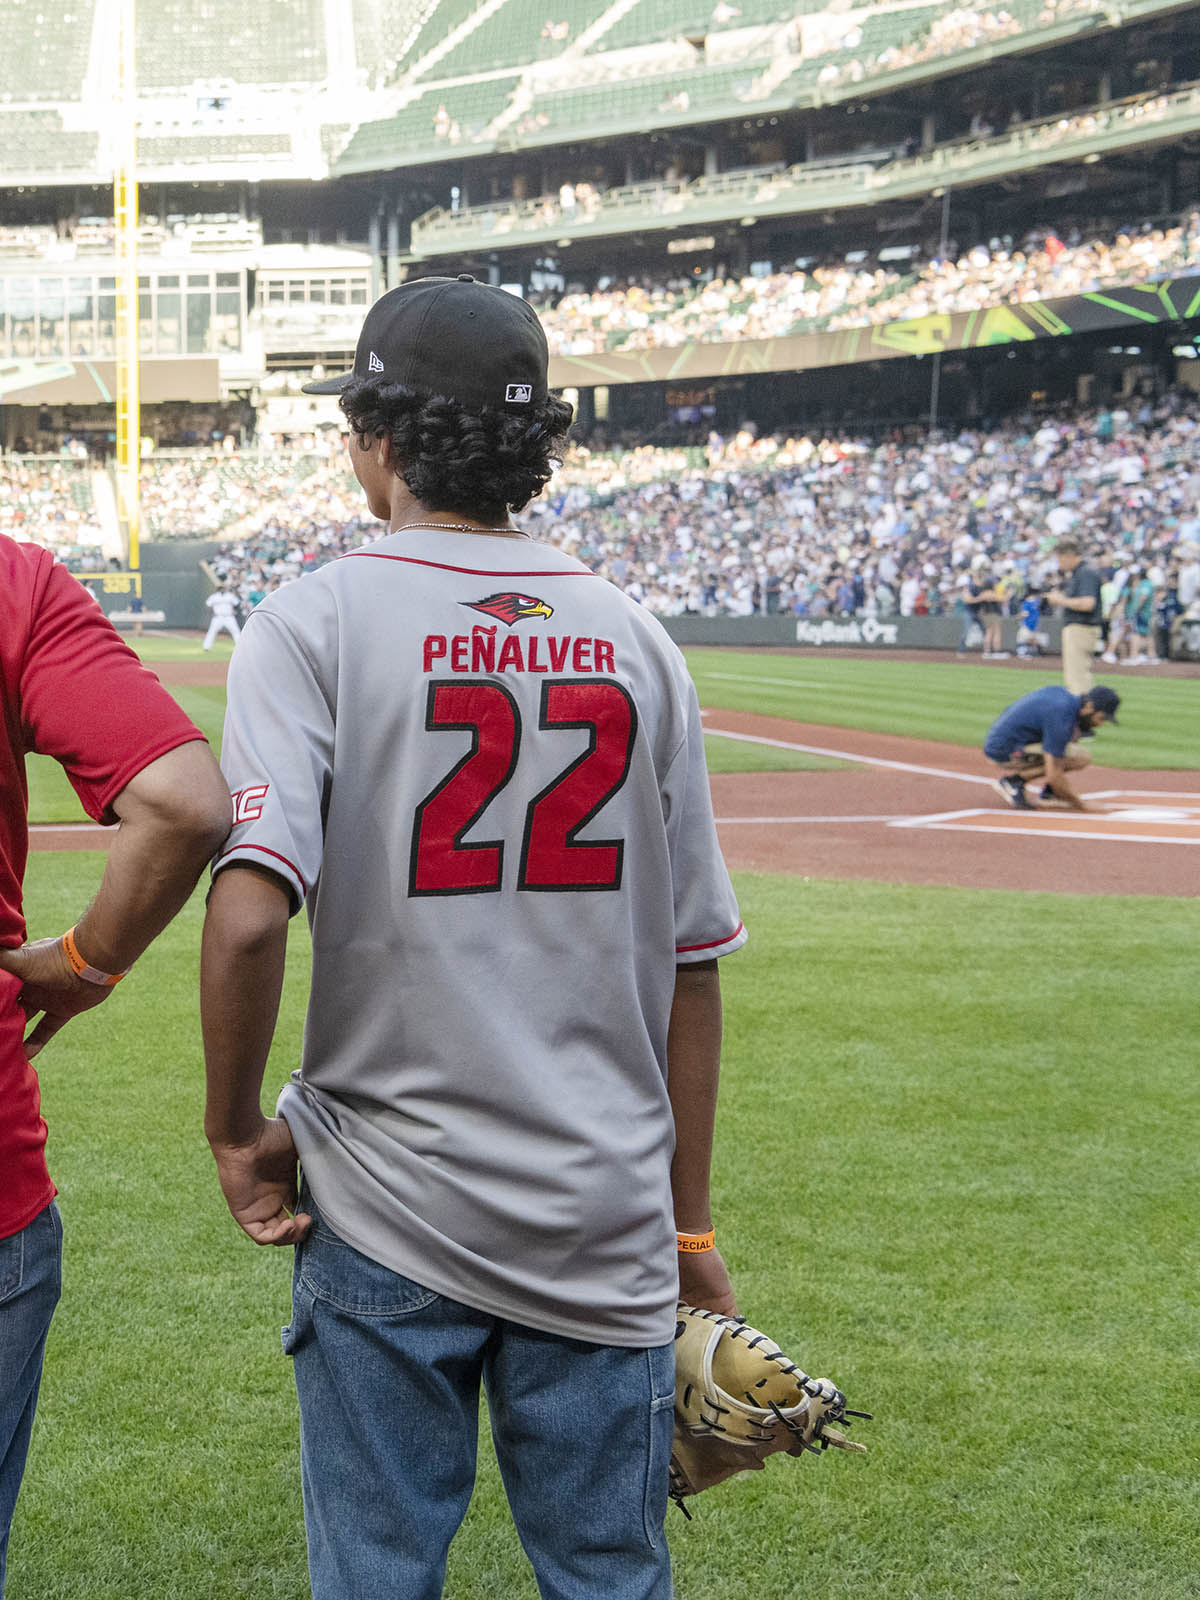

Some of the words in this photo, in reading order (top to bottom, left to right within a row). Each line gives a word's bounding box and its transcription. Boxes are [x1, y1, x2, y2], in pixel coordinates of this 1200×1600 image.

[423, 625, 616, 673] PEÑALVER
[408, 678, 638, 898] 22
[677, 1240, 711, 1250] PECIAL
